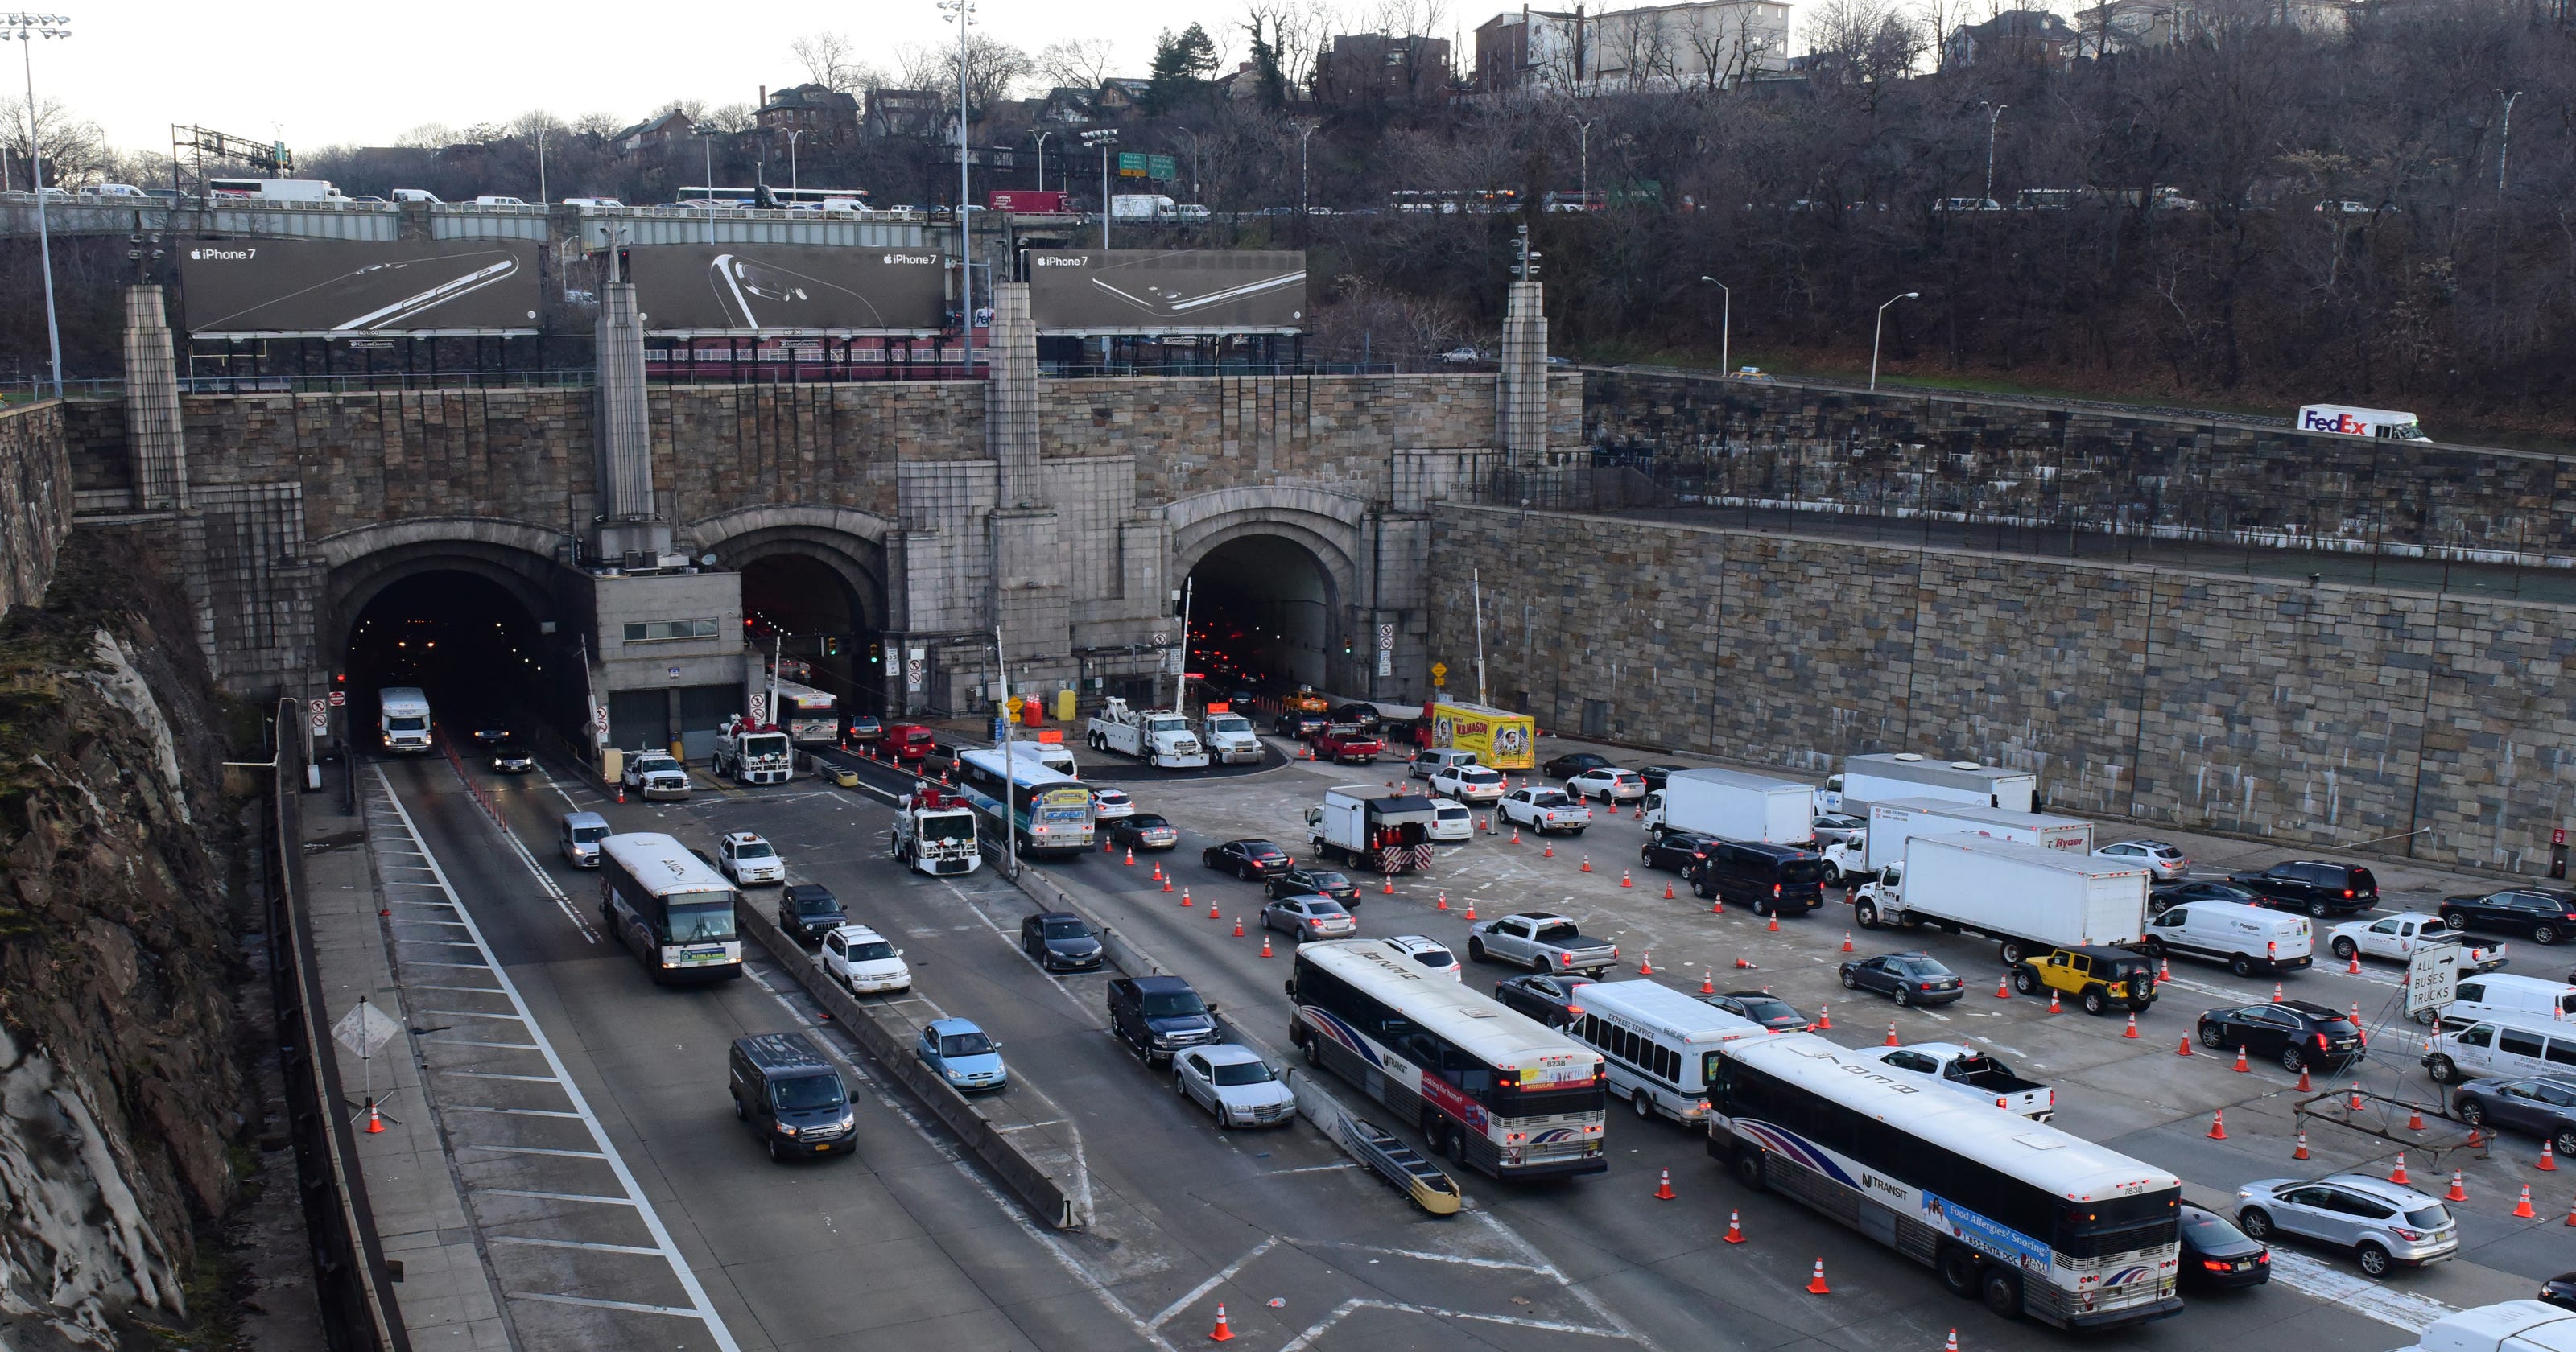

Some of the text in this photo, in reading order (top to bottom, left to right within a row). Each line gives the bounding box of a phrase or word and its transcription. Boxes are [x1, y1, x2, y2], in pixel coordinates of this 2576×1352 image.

[202, 249, 256, 260] iPhone 7
[894, 254, 937, 264] iPhone 7
[1046, 256, 1088, 266] iPhone 7
[2305, 410, 2367, 435] FedEx
[2055, 838, 2083, 848] Ryder
[2239, 922, 2260, 931] Penguin
[2417, 960, 2432, 973] ALL
[2415, 972, 2445, 989] BUSES
[2414, 987, 2449, 1005] TRUCKS
[1608, 1013, 1630, 1028] EXPRESS
[1633, 1024, 1655, 1040] SERVICE
[1389, 1056, 1408, 1075] TRANSIT
[2514, 1061, 2537, 1070] KITCHENS
[2520, 1057, 2543, 1065] INTERIOR
[1422, 1073, 1439, 1091] Looking
[1447, 1088, 1463, 1105] home?
[1862, 1173, 1908, 1201] NJ TRANSIT
[2124, 1185, 2143, 1195] 7838
[1950, 1205, 1970, 1220] Food
[1971, 1214, 2010, 1239] Allergies?
[2012, 1230, 2050, 1257] Snoring?
[1963, 1234, 2019, 1265] 1-855-ENTA-DOC
